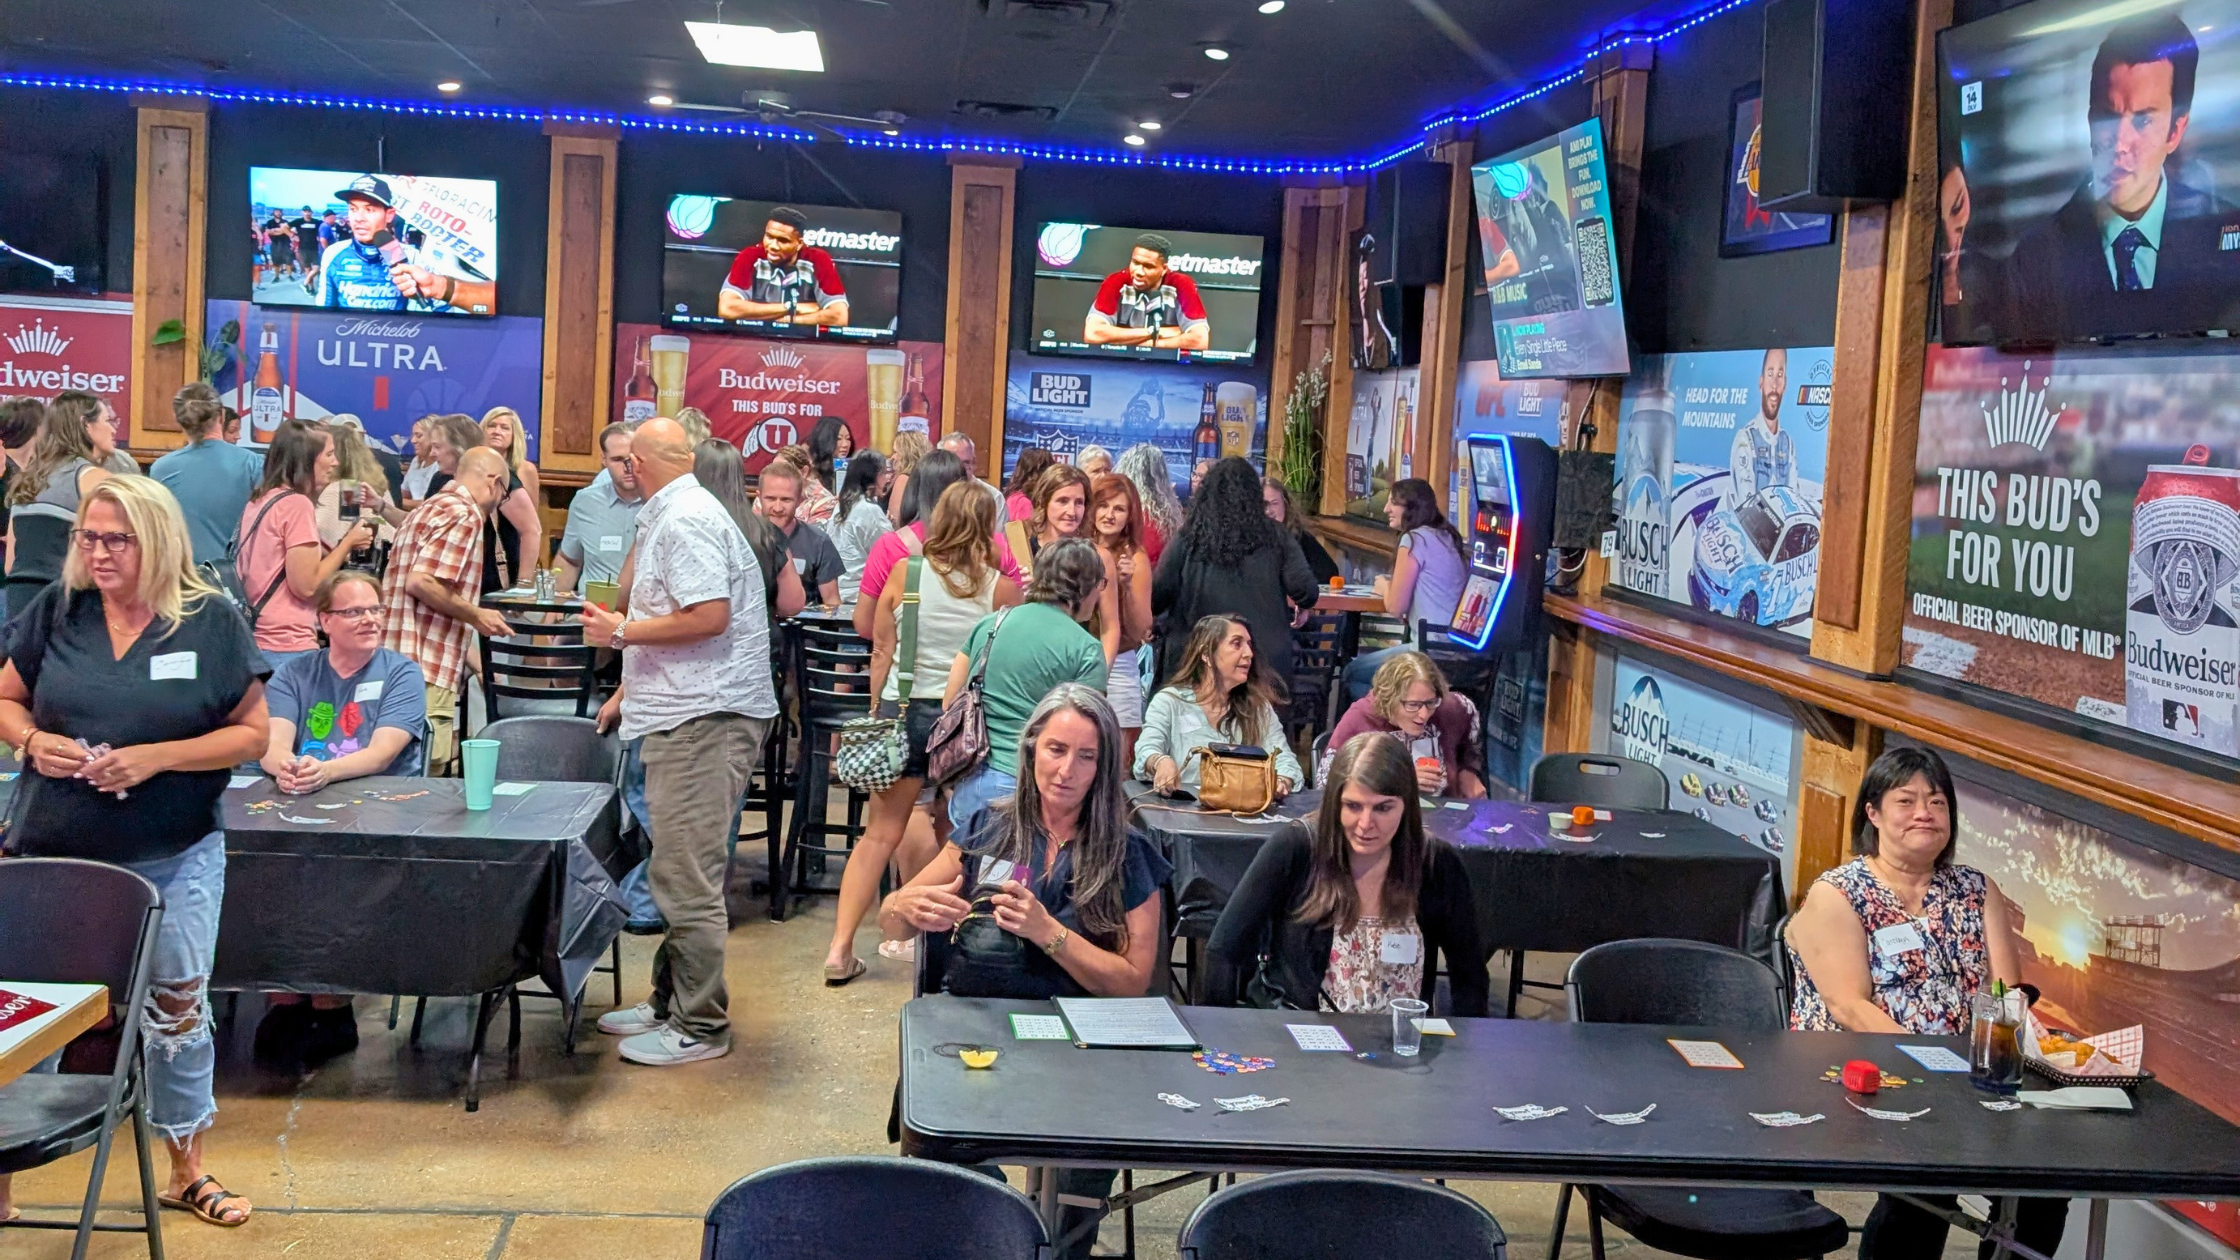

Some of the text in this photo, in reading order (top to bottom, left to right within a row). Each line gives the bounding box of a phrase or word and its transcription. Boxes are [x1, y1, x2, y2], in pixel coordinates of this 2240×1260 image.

[1966, 91, 1977, 104] 14
[1579, 135, 1593, 151] PLAY
[1568, 149, 1599, 170] BRINGS THE
[1571, 179, 1602, 199] DOWNLOAD
[418, 200, 473, 236] ROTO-
[803, 227, 899, 252] etmaster
[1168, 253, 1261, 276] etmaster
[1506, 283, 1528, 303] MUSIC
[336, 317, 423, 338] Michelob
[317, 339, 444, 371] ULTRA
[1527, 339, 1541, 357] Single
[1552, 337, 1567, 352] Piece
[719, 368, 840, 395] Budweiser
[1041, 374, 1081, 390] BUD
[1523, 382, 1540, 396] BUD
[1032, 388, 1088, 405] LIGHT
[1519, 397, 1541, 413] LIGHT
[1685, 388, 1749, 404] HEAD FOR THE
[253, 404, 281, 412] ULTRA
[732, 399, 822, 417] THIS BUD'S FOR
[1682, 411, 1736, 430] MOUNTAINS
[1938, 467, 2101, 537] THIS BUD'S
[1621, 518, 1669, 571] BUSCH
[1702, 533, 1722, 564] LIGHT
[1705, 515, 1743, 576] BUSCH
[1784, 555, 1812, 586] BUSCH
[1947, 529, 2001, 588] FOR
[2012, 538, 2075, 602] YOU
[1627, 567, 1659, 594] LIGHT
[1913, 592, 1960, 625] OFFICIAL
[1962, 603, 1993, 633] BEER
[1995, 610, 2058, 648] SPONSOR
[2061, 624, 2080, 652] OF
[2128, 630, 2236, 685] Budweiser
[2151, 678, 2172, 689] BEER
[2174, 683, 2214, 697] SPONSOR
[2216, 690, 2224, 699] OF
[1621, 702, 1669, 755] BUSCH
[1629, 743, 1657, 765] LIGHT
